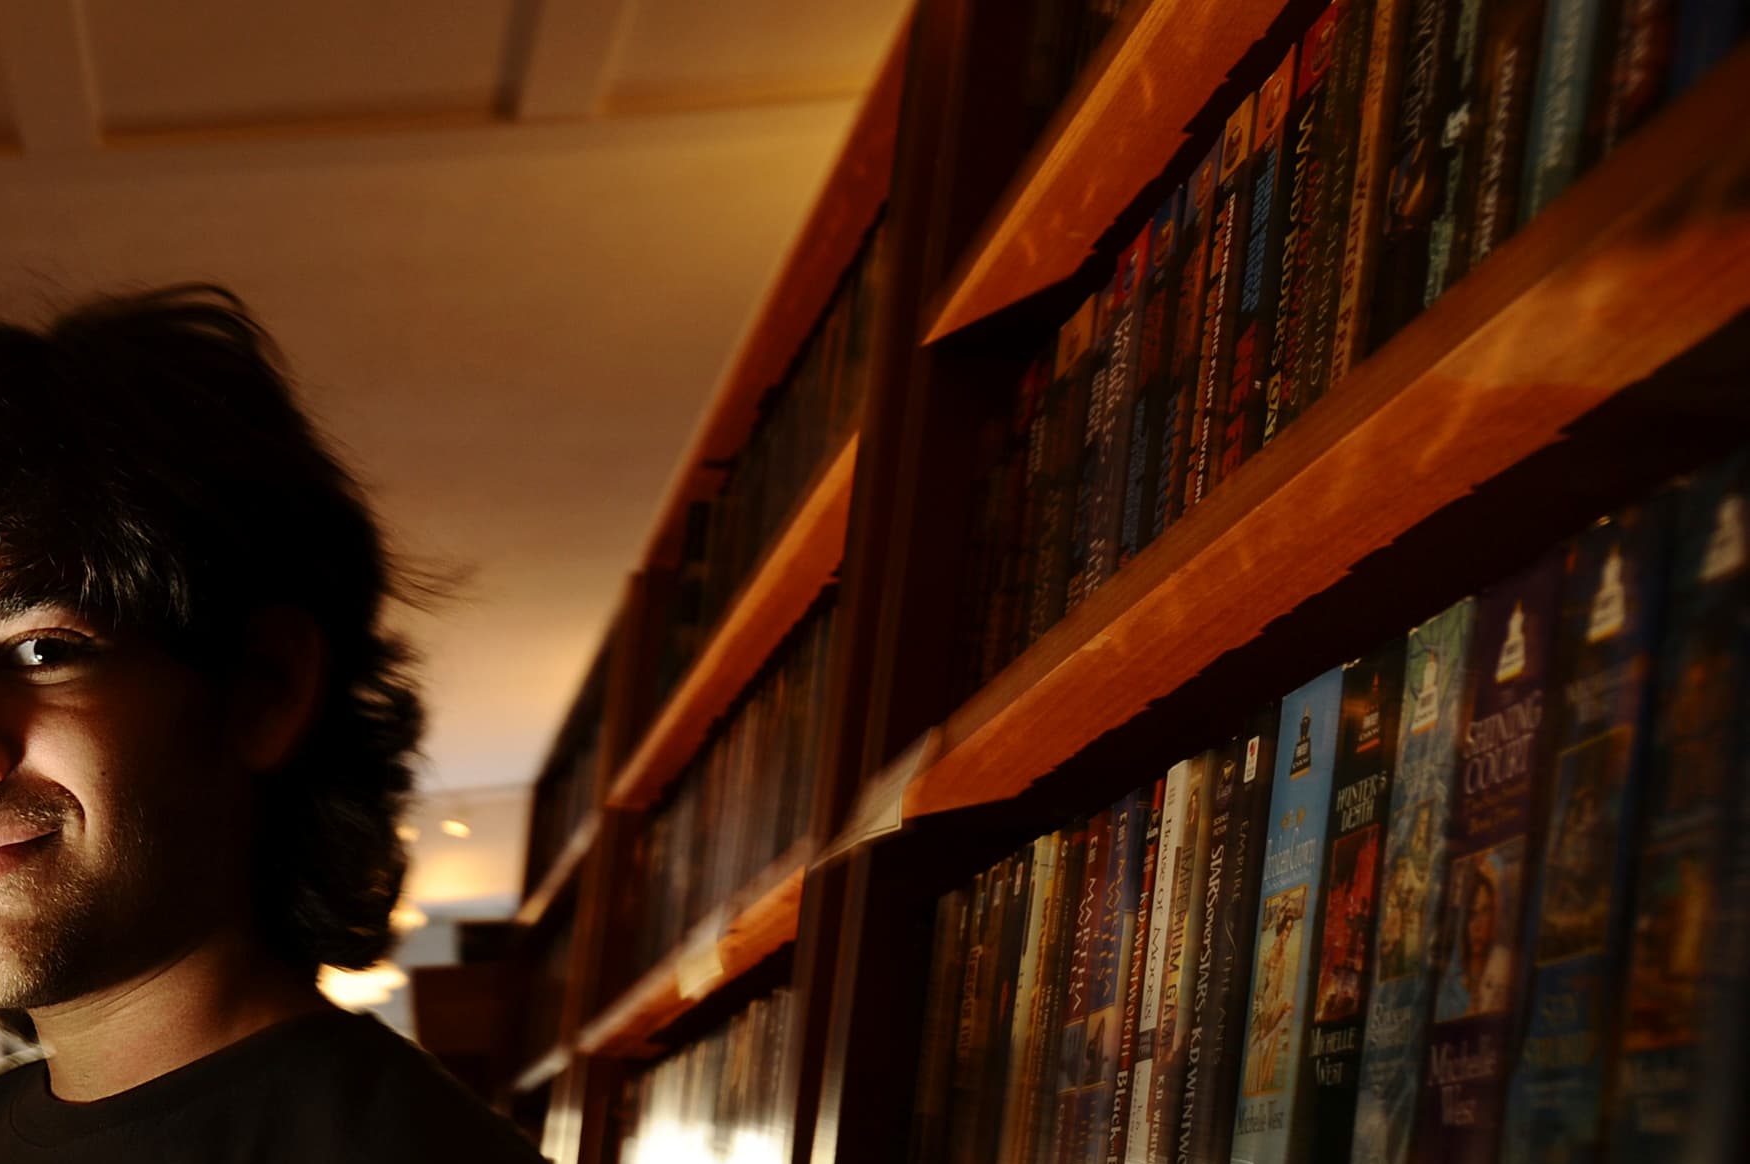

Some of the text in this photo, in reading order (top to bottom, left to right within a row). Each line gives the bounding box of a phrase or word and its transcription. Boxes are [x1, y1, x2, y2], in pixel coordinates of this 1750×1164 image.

[1289, 99, 1317, 222] WIND
[1224, 193, 1237, 246] DAVID
[1217, 247, 1230, 309] WEBER
[1270, 225, 1299, 367] RIDER'S
[1211, 314, 1223, 358] ERIC
[1204, 358, 1216, 409] FLINT
[1197, 417, 1210, 471] DAVID
[1232, 818, 1250, 904] EMPIRE
[1067, 899, 1088, 995] WELLS
[1072, 877, 1097, 1013] MARTHA
[1167, 846, 1194, 974] IMPERIUM
[1120, 927, 1144, 1057] WENTWORTH
[1109, 1070, 1130, 1141] Black
